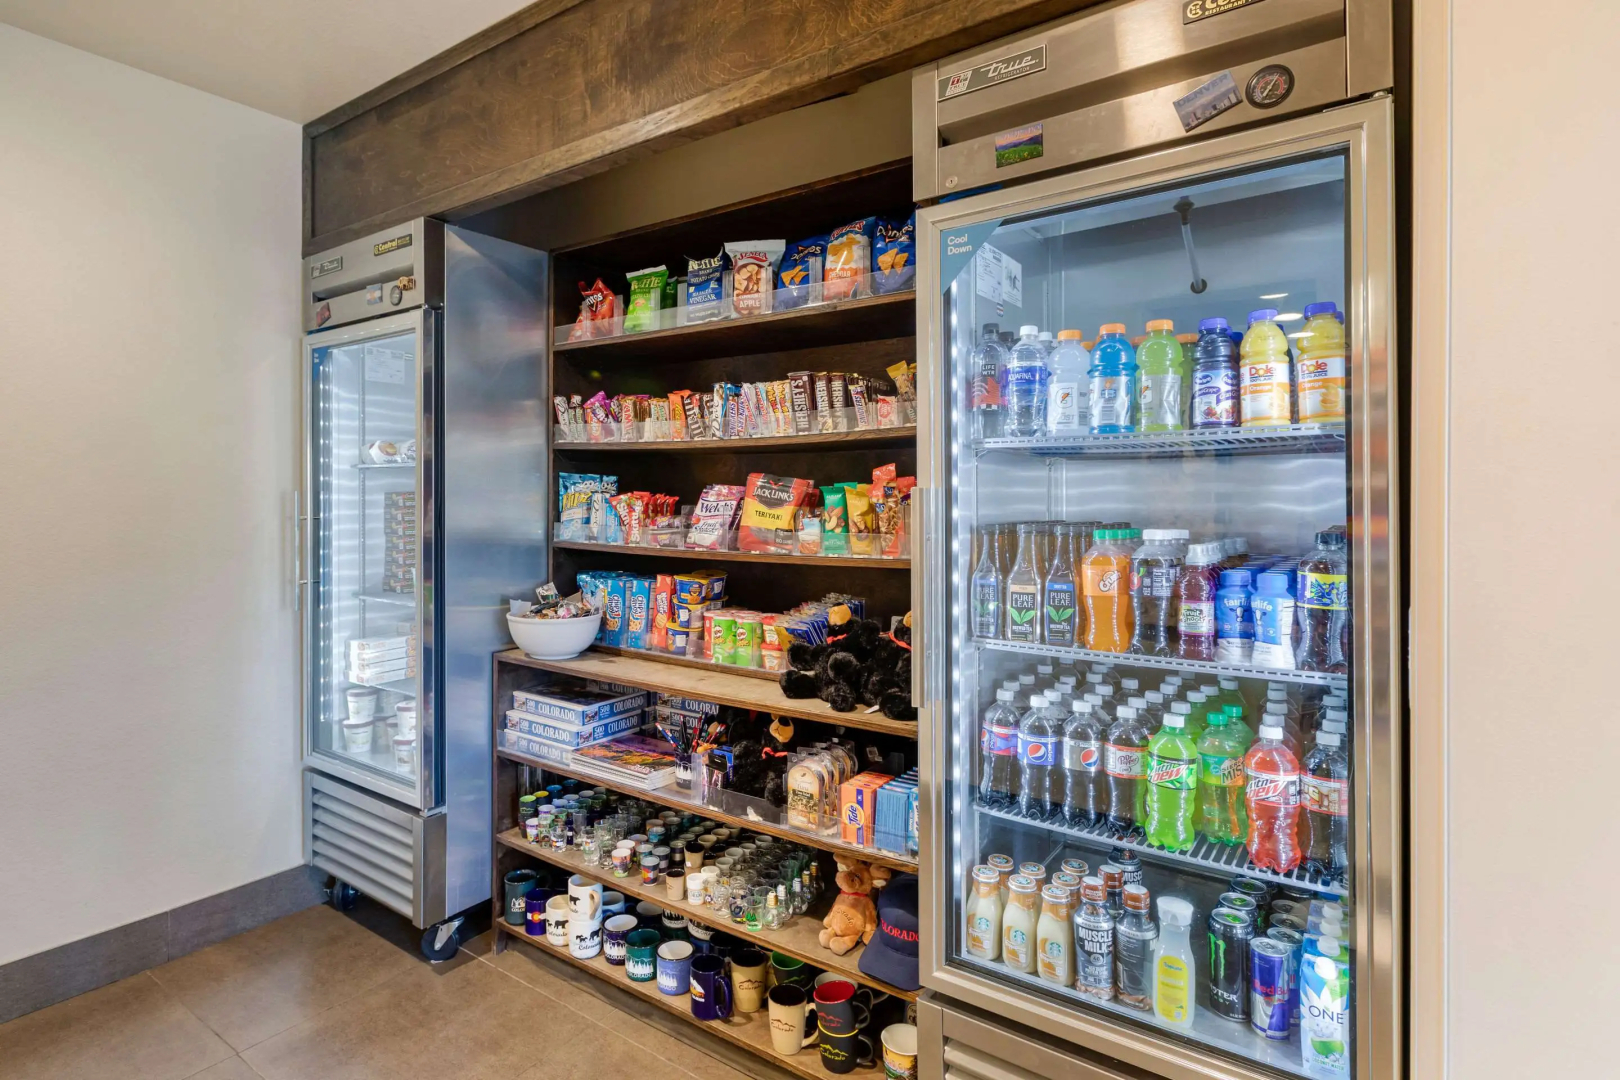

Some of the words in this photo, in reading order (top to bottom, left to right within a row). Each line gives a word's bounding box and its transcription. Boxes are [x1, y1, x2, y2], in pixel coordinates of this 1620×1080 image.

[994, 66, 1030, 80] REFRIGERATOR
[1176, 73, 1228, 106] DENVER
[378, 239, 398, 251] Central
[948, 234, 968, 245] Cool
[738, 251, 768, 260] SENECA
[948, 245, 972, 255] Down
[690, 294, 717, 304] VINEGAR
[739, 299, 761, 308] APPLE
[1249, 364, 1276, 377] Dole
[1301, 361, 1327, 374] Dole
[1007, 371, 1032, 382] AQUAFINA
[1301, 380, 1323, 389] Orange
[791, 379, 809, 428] HERSHEY'S
[855, 396, 867, 424] SNICKERS
[753, 486, 771, 498] JACK
[754, 510, 783, 521] TERIYAKI
[1012, 594, 1034, 602] PURE
[1050, 592, 1071, 600] PURE
[1183, 609, 1201, 617] Fruit
[526, 700, 536, 709] 500
[538, 703, 575, 720] COLORADO
[600, 705, 610, 713] 500
[613, 696, 643, 713] COLORADO
[685, 700, 719, 714] COLORA
[520, 720, 529, 728] 500
[532, 723, 570, 742] COLORADO
[594, 725, 604, 735] 500
[607, 716, 638, 733] COLORADO
[524, 742, 561, 760] COLORADO
[1118, 757, 1139, 767] Pepper
[1221, 766, 1244, 785] MIS
[848, 805, 860, 825] Tide
[1123, 869, 1142, 882] MUSC
[881, 918, 919, 942] LORAD
[1078, 926, 1113, 942] MUSCLE
[1084, 940, 1108, 953] MILK
[1254, 980, 1275, 995] Red
[1309, 1005, 1344, 1025] ONE
[771, 1021, 795, 1032] Colorado
[820, 1048, 846, 1061] Colorado
[1312, 1057, 1330, 1067] COCONUT
[1330, 1062, 1345, 1072] WATER
